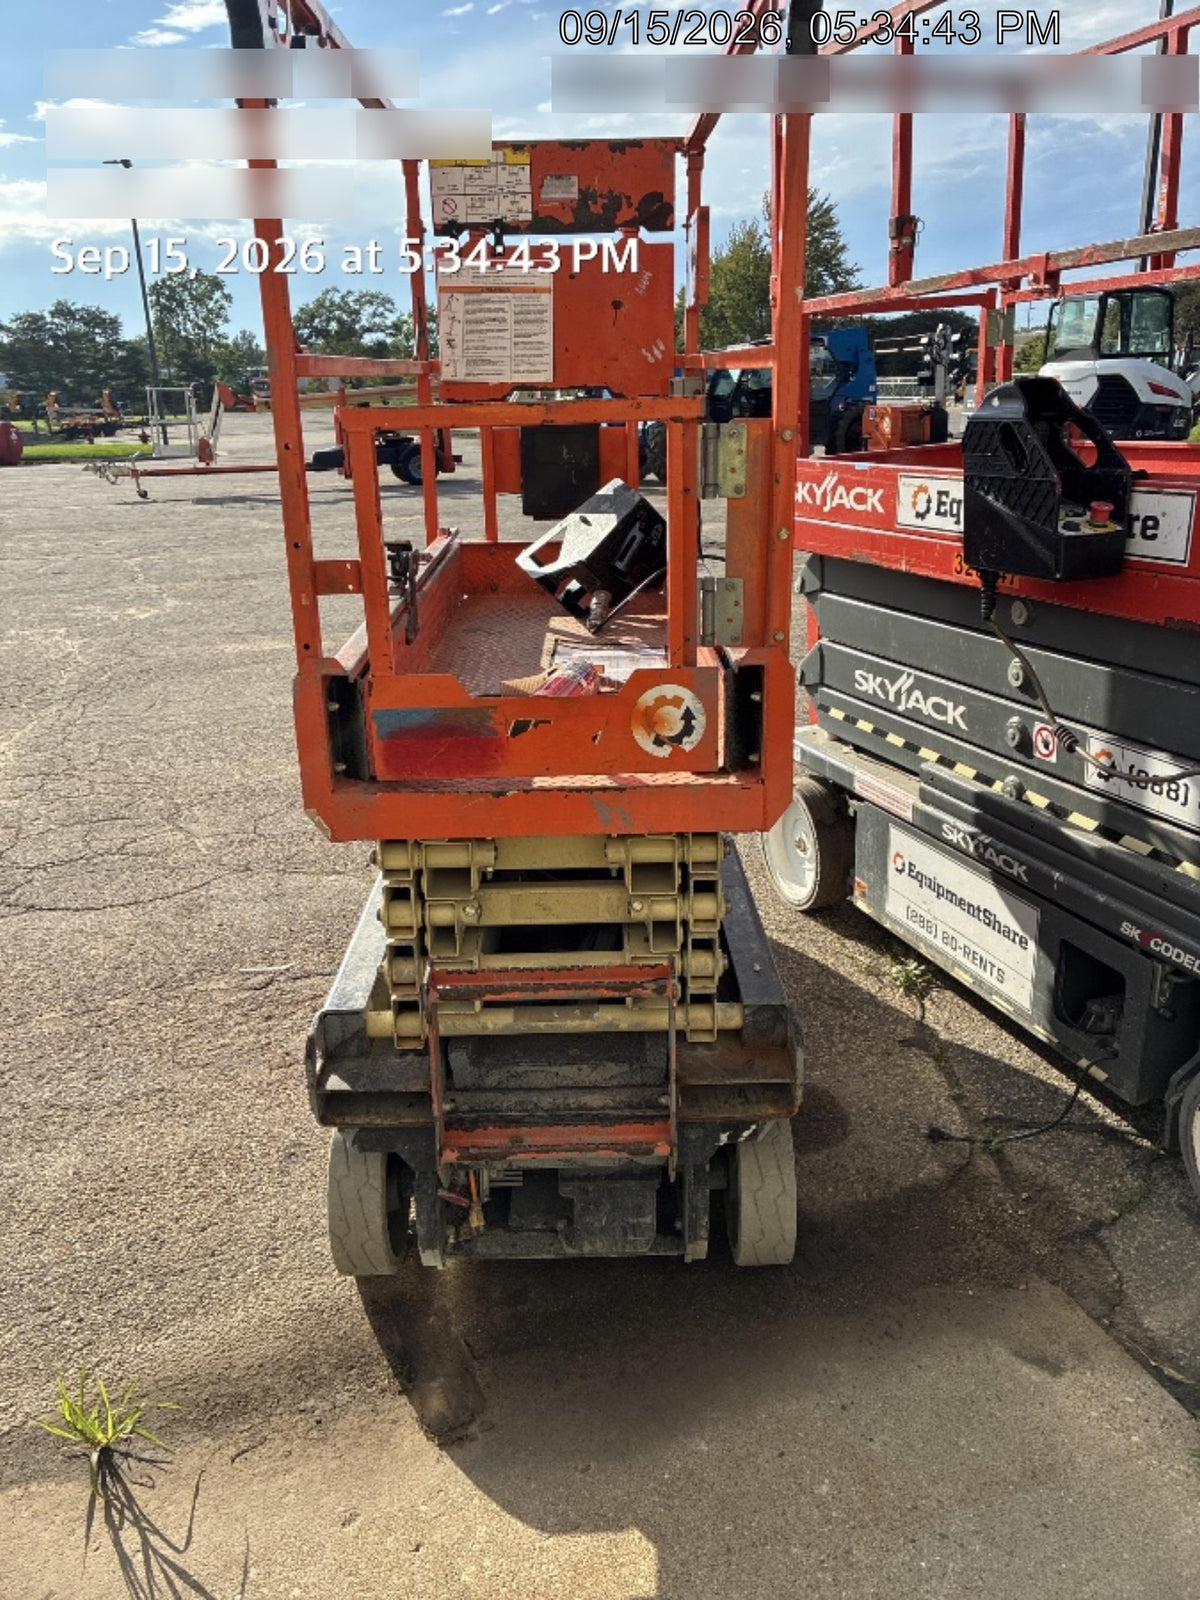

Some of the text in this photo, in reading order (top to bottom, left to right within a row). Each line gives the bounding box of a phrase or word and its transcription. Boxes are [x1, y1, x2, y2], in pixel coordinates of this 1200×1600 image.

[795, 471, 885, 513] KYJACK
[854, 671, 968, 730] SKYJACK
[907, 861, 1029, 950] EquipmentShare
